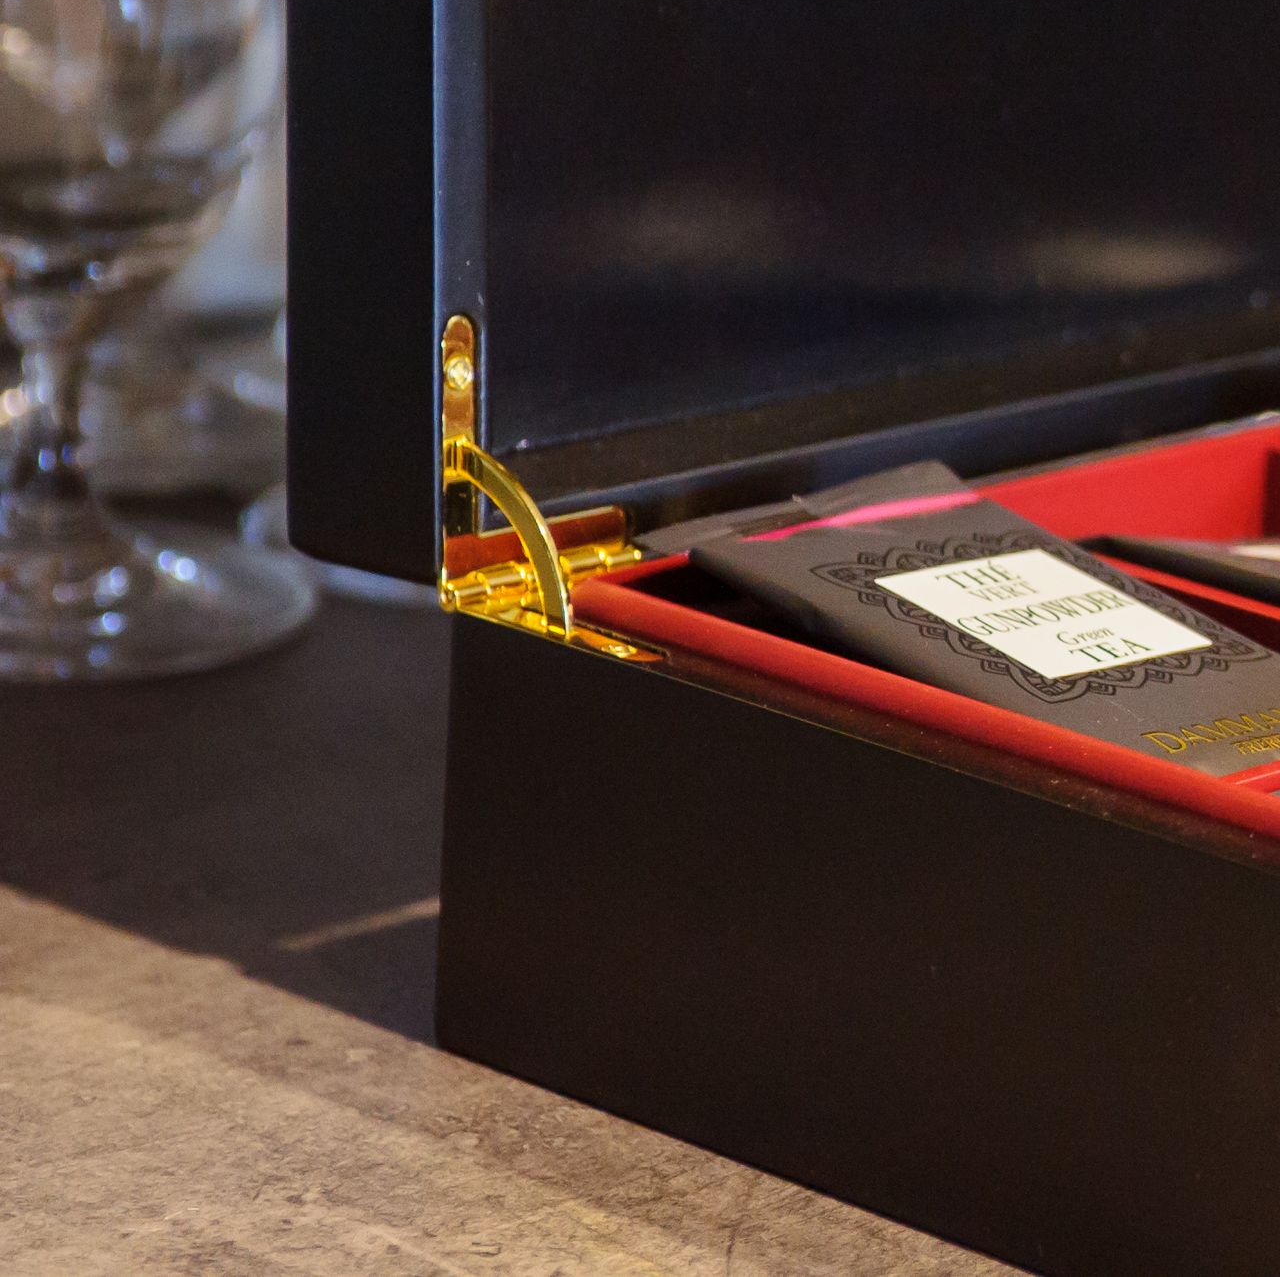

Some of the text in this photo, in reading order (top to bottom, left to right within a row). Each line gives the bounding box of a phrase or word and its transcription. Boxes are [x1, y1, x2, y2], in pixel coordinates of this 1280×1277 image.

[937, 560, 1022, 591] THÉ
[968, 581, 1040, 603] VERT
[956, 590, 1136, 637] GUNPOWDER
[1056, 626, 1116, 647] Green
[1068, 637, 1153, 664] TEA
